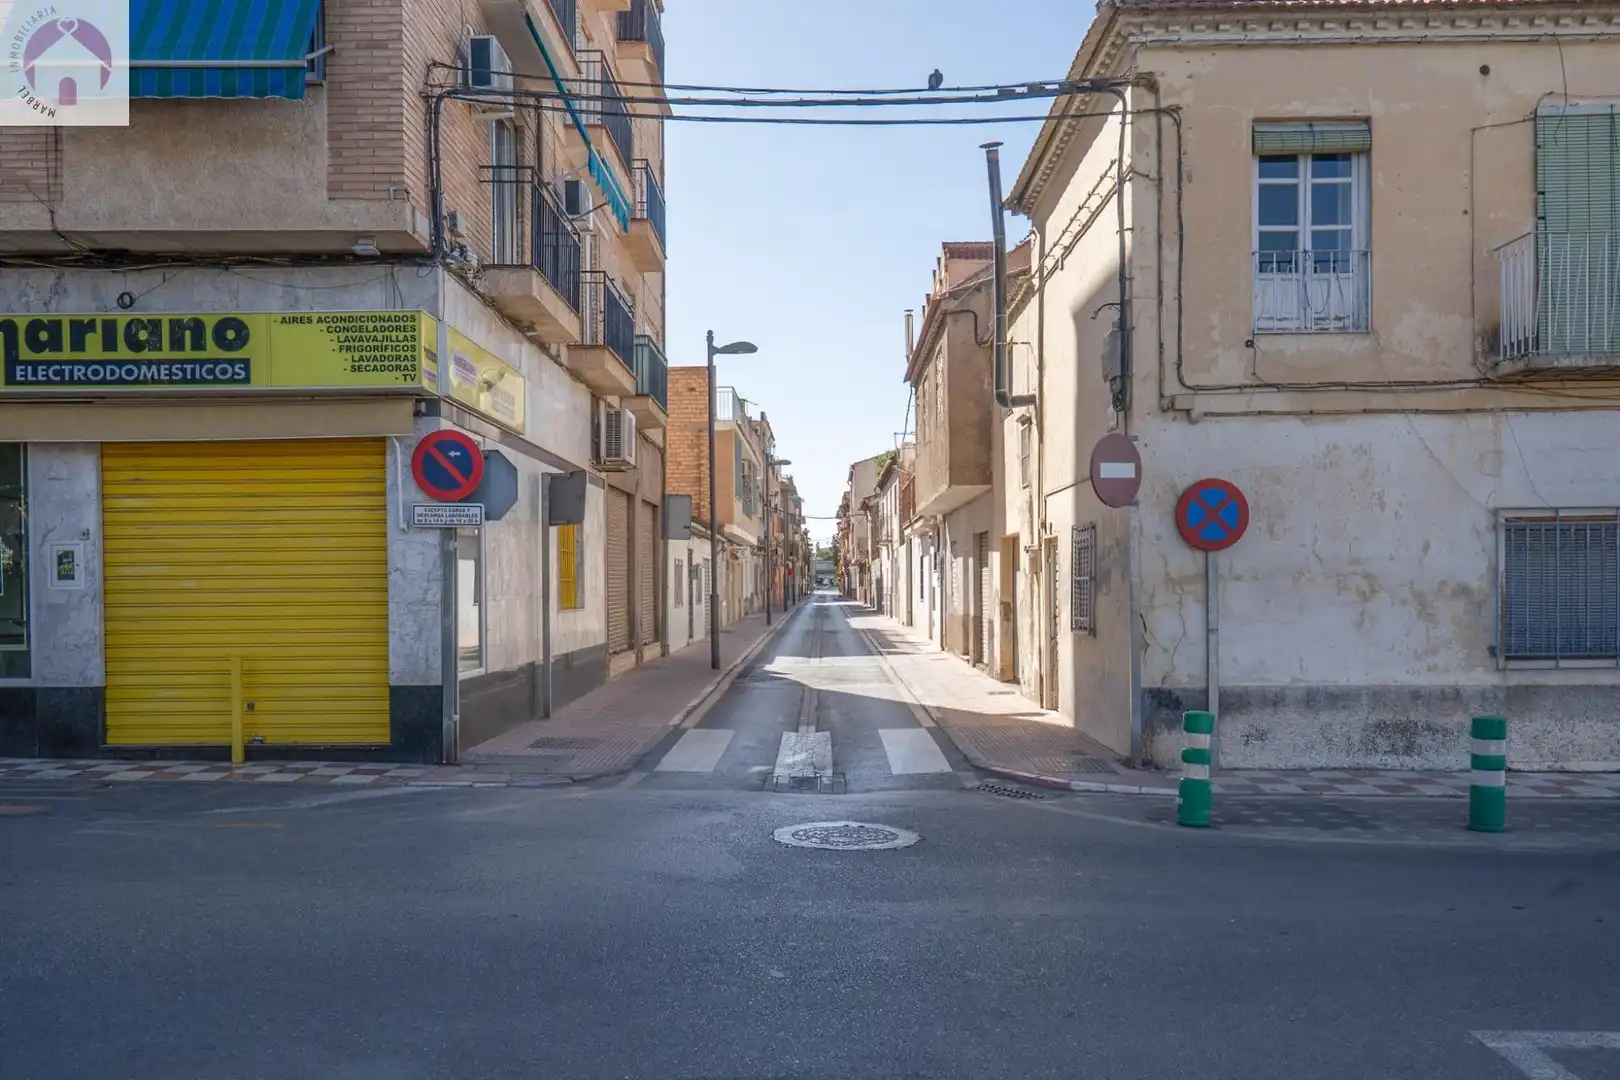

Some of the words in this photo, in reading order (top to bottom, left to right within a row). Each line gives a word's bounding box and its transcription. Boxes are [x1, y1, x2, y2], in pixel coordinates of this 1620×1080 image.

[280, 316, 313, 325] AIRES
[316, 315, 417, 324] ACONDICIONADOS
[326, 325, 417, 334] CONGELADORES
[337, 334, 417, 343] LAVAVAJILLAS
[339, 343, 417, 353] FRIGORÍFICOS
[351, 354, 417, 363] LAVADORAS
[15, 363, 247, 382] ELECTRODOMESTICOS
[350, 364, 417, 373] SECADORAS
[402, 374, 417, 382] TV
